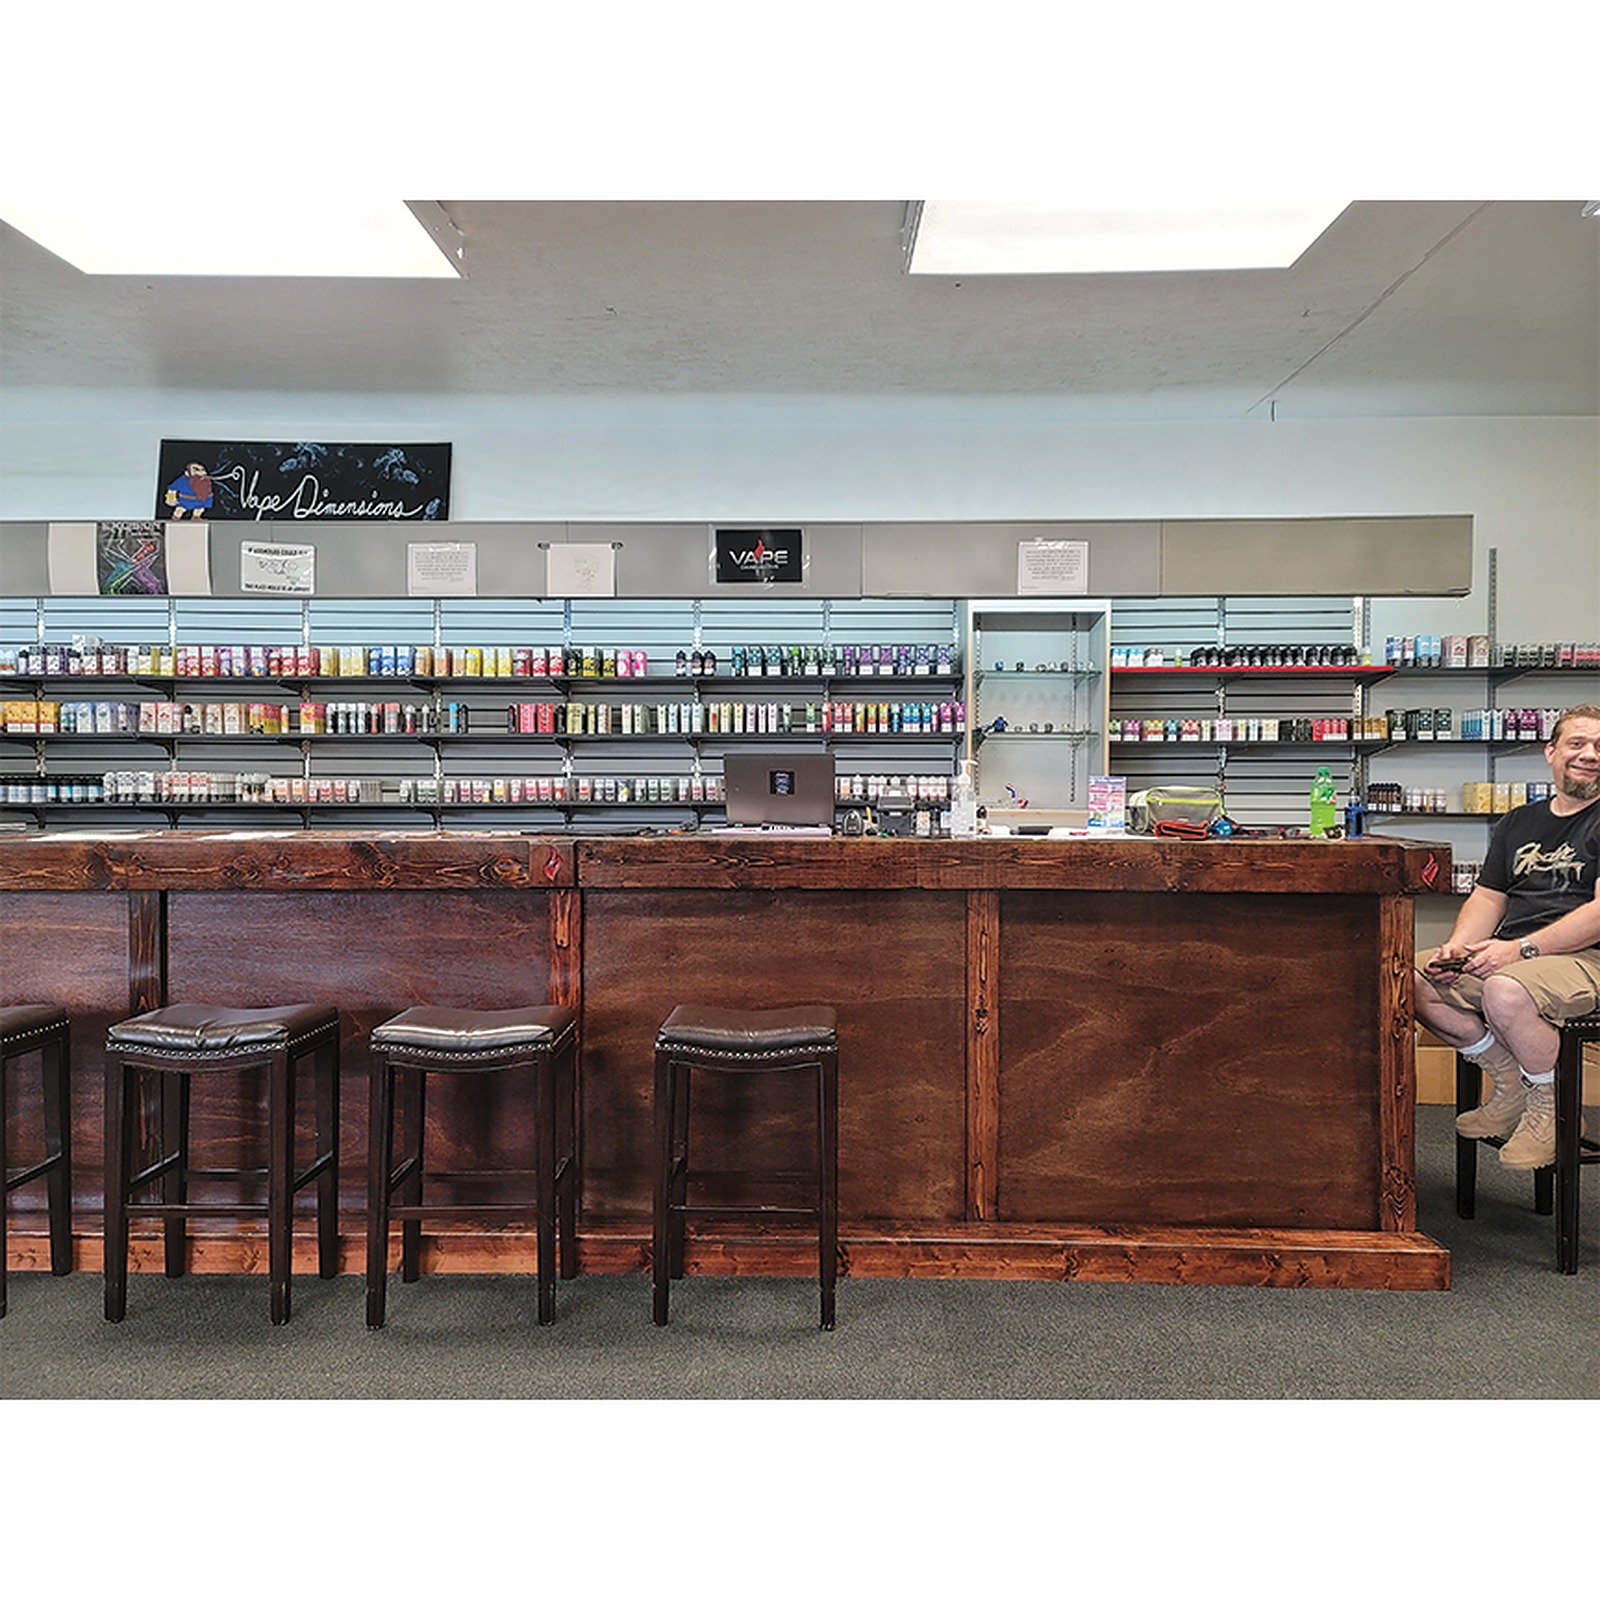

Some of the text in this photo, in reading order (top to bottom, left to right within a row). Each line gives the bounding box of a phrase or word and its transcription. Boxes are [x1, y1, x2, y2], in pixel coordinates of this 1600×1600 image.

[231, 465, 423, 521] Vape Dimensions
[729, 550, 788, 565] VAPE
